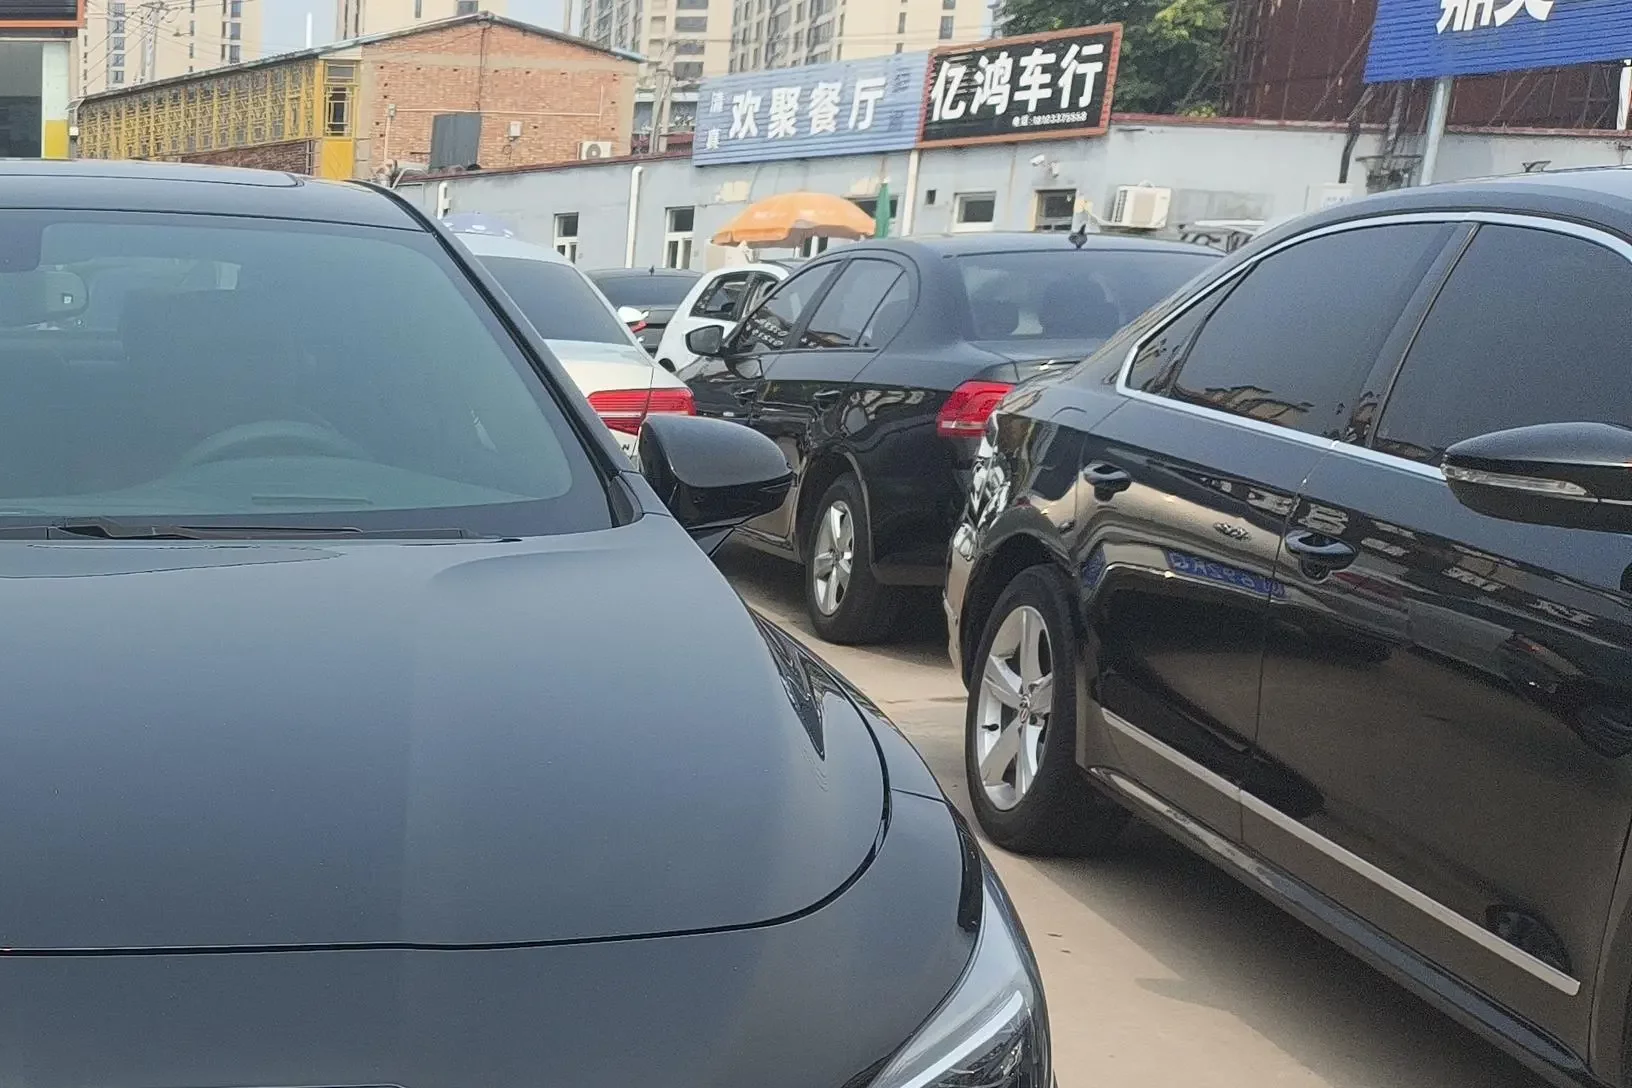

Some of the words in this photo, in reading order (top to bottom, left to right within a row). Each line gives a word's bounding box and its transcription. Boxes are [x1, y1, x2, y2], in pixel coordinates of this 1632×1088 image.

[728, 77, 887, 140] 欢聚餐厅
[930, 43, 1105, 122] 亿鸿车行
